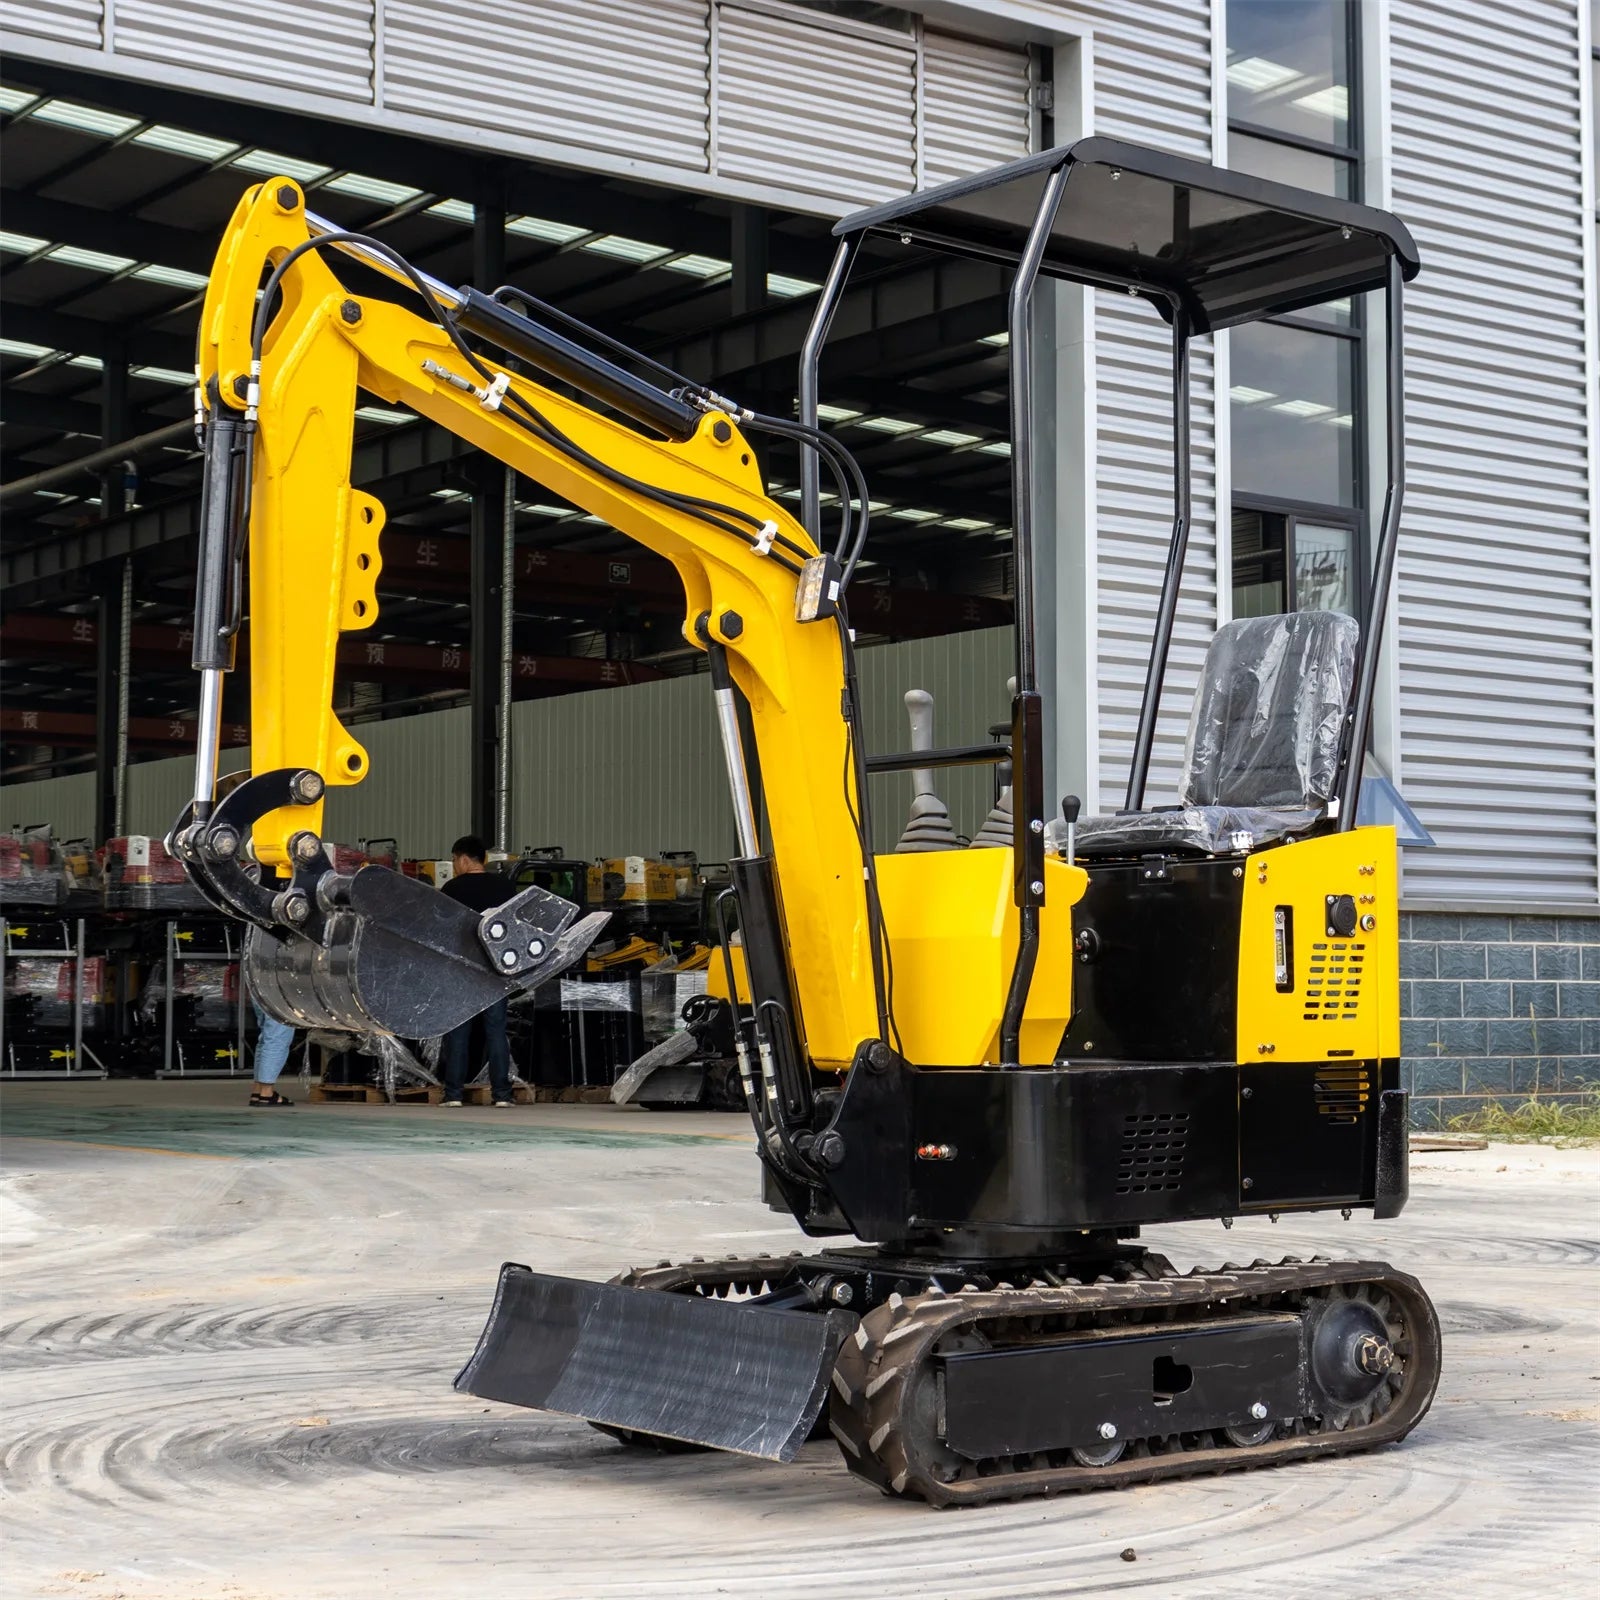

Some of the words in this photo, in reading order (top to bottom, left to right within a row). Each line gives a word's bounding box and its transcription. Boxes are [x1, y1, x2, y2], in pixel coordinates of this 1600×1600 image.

[416, 539, 439, 566] 生
[72, 619, 94, 642] 生
[366, 643, 385, 664] 预
[442, 648, 461, 669] 防
[519, 655, 537, 675] 为
[600, 661, 617, 682] 主
[169, 720, 186, 738] 为
[232, 725, 249, 743] 主
